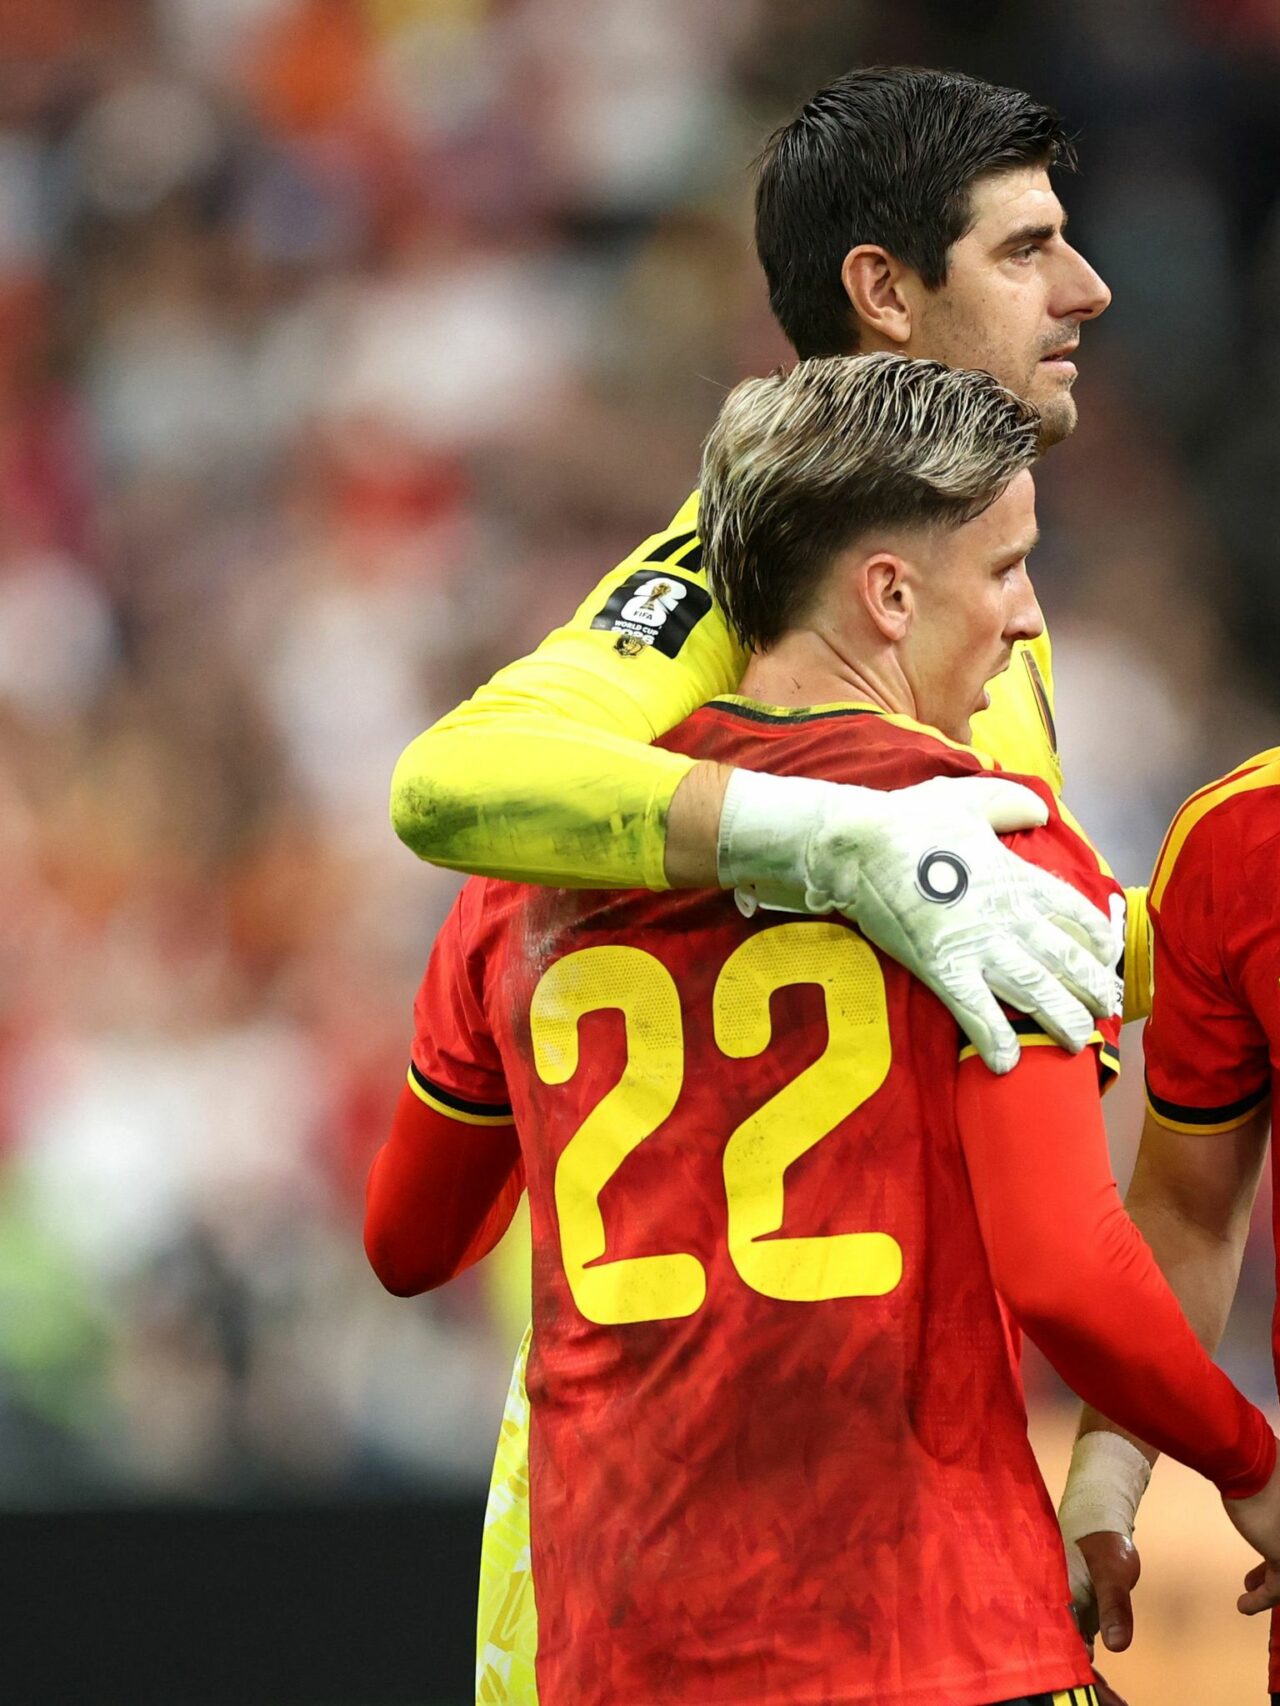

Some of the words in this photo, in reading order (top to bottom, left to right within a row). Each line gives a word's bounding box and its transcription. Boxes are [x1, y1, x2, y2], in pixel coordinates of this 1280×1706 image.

[633, 610, 653, 620] FIFA
[614, 620, 642, 631] WORLD
[642, 626, 659, 635] CUP
[529, 921, 903, 1325] 22
